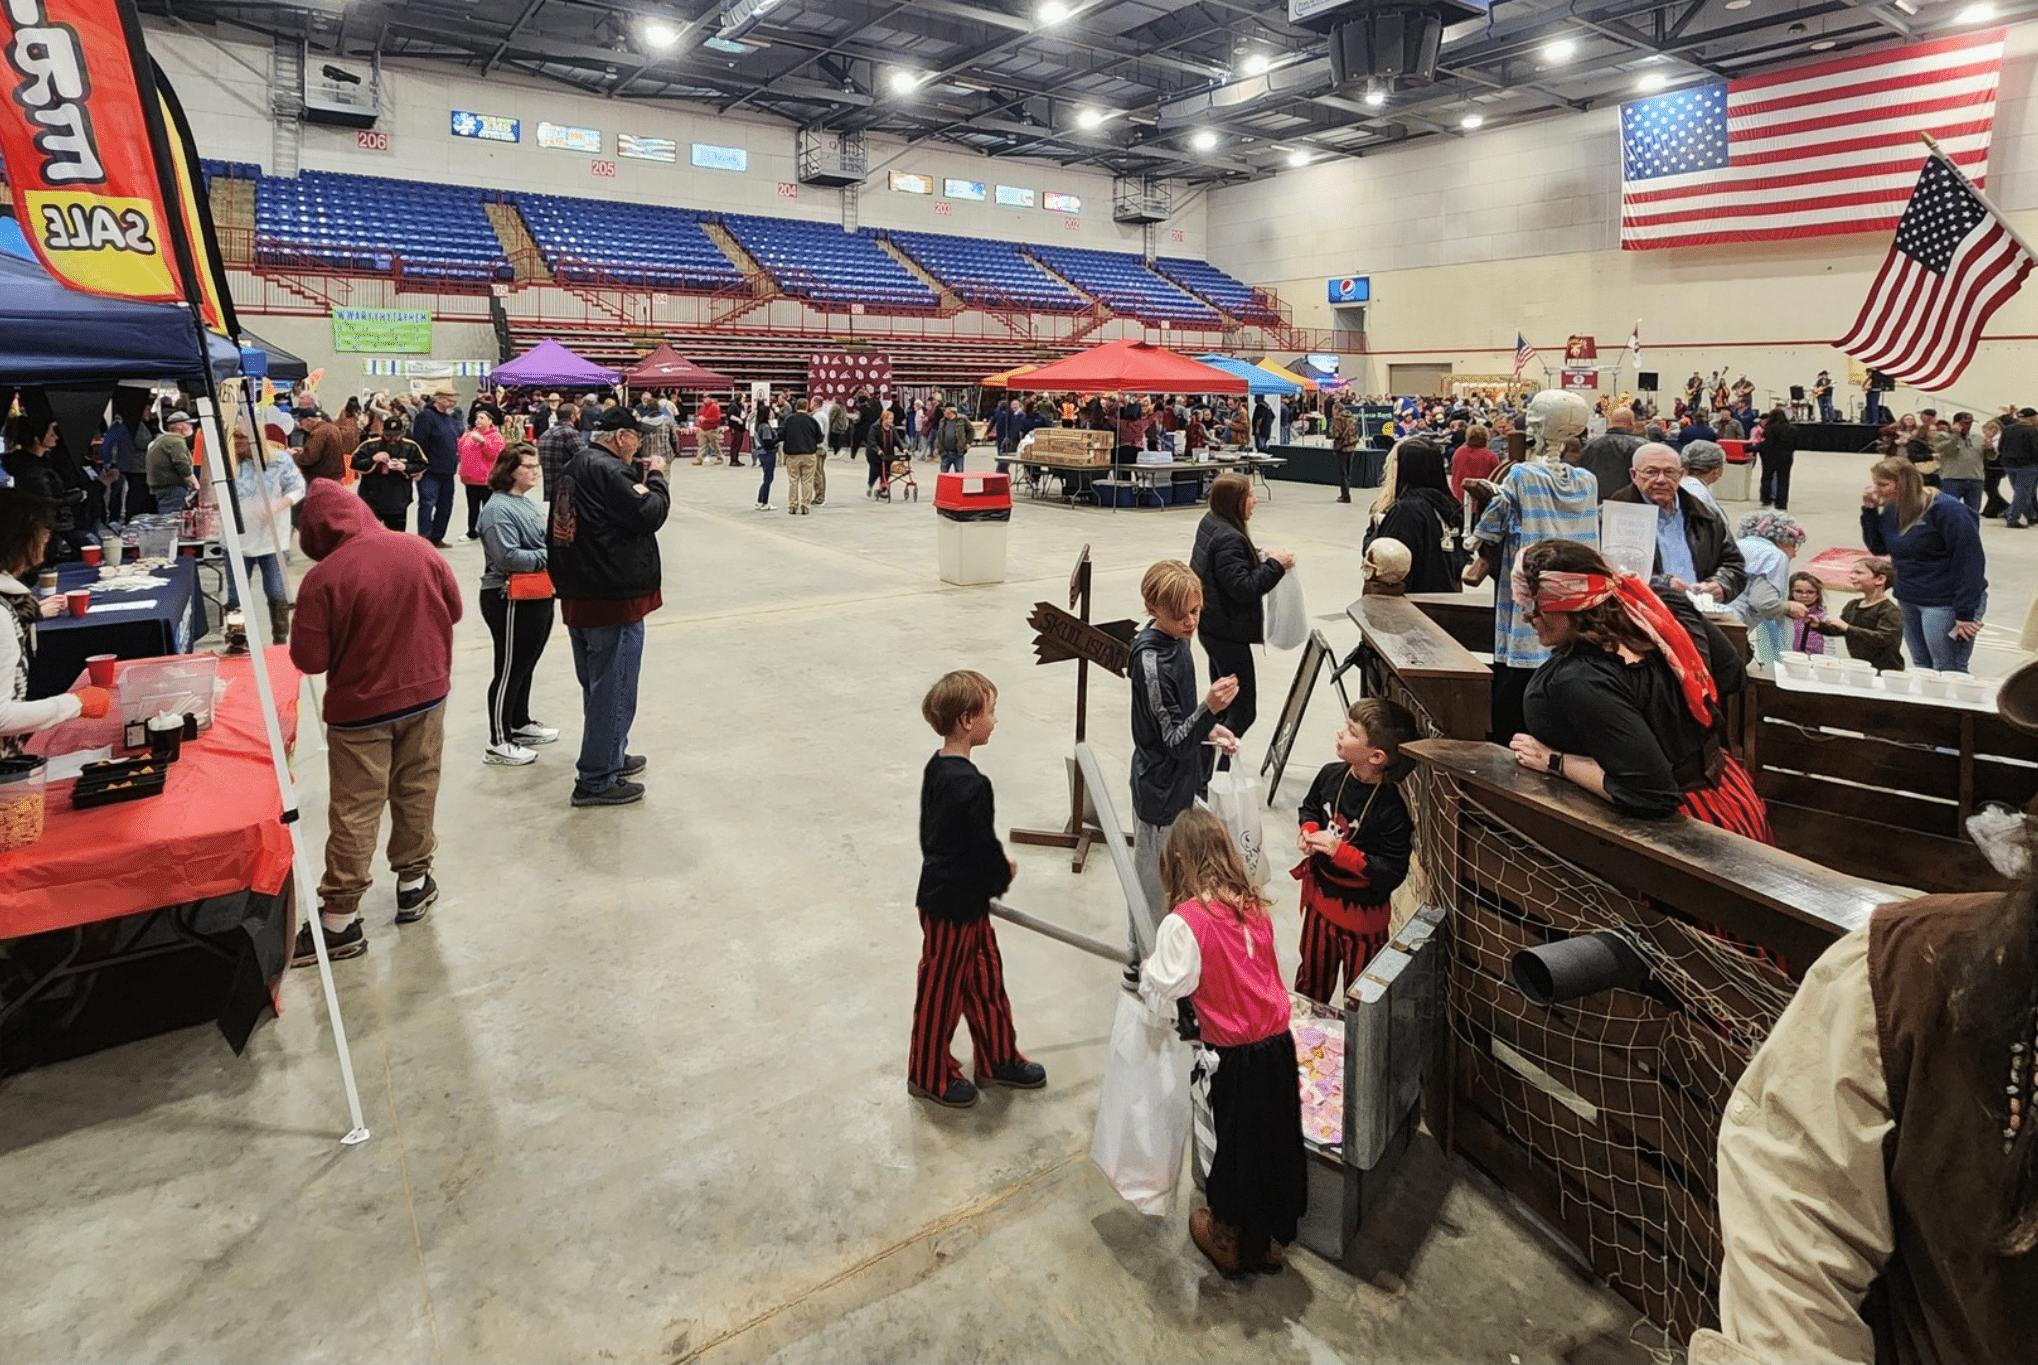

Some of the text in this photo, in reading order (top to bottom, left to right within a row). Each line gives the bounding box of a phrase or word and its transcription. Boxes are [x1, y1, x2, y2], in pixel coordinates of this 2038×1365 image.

[358, 132, 386, 150] 206
[592, 161, 615, 176] 205
[778, 183, 797, 197] 204
[1041, 613, 1082, 646] SKULL
